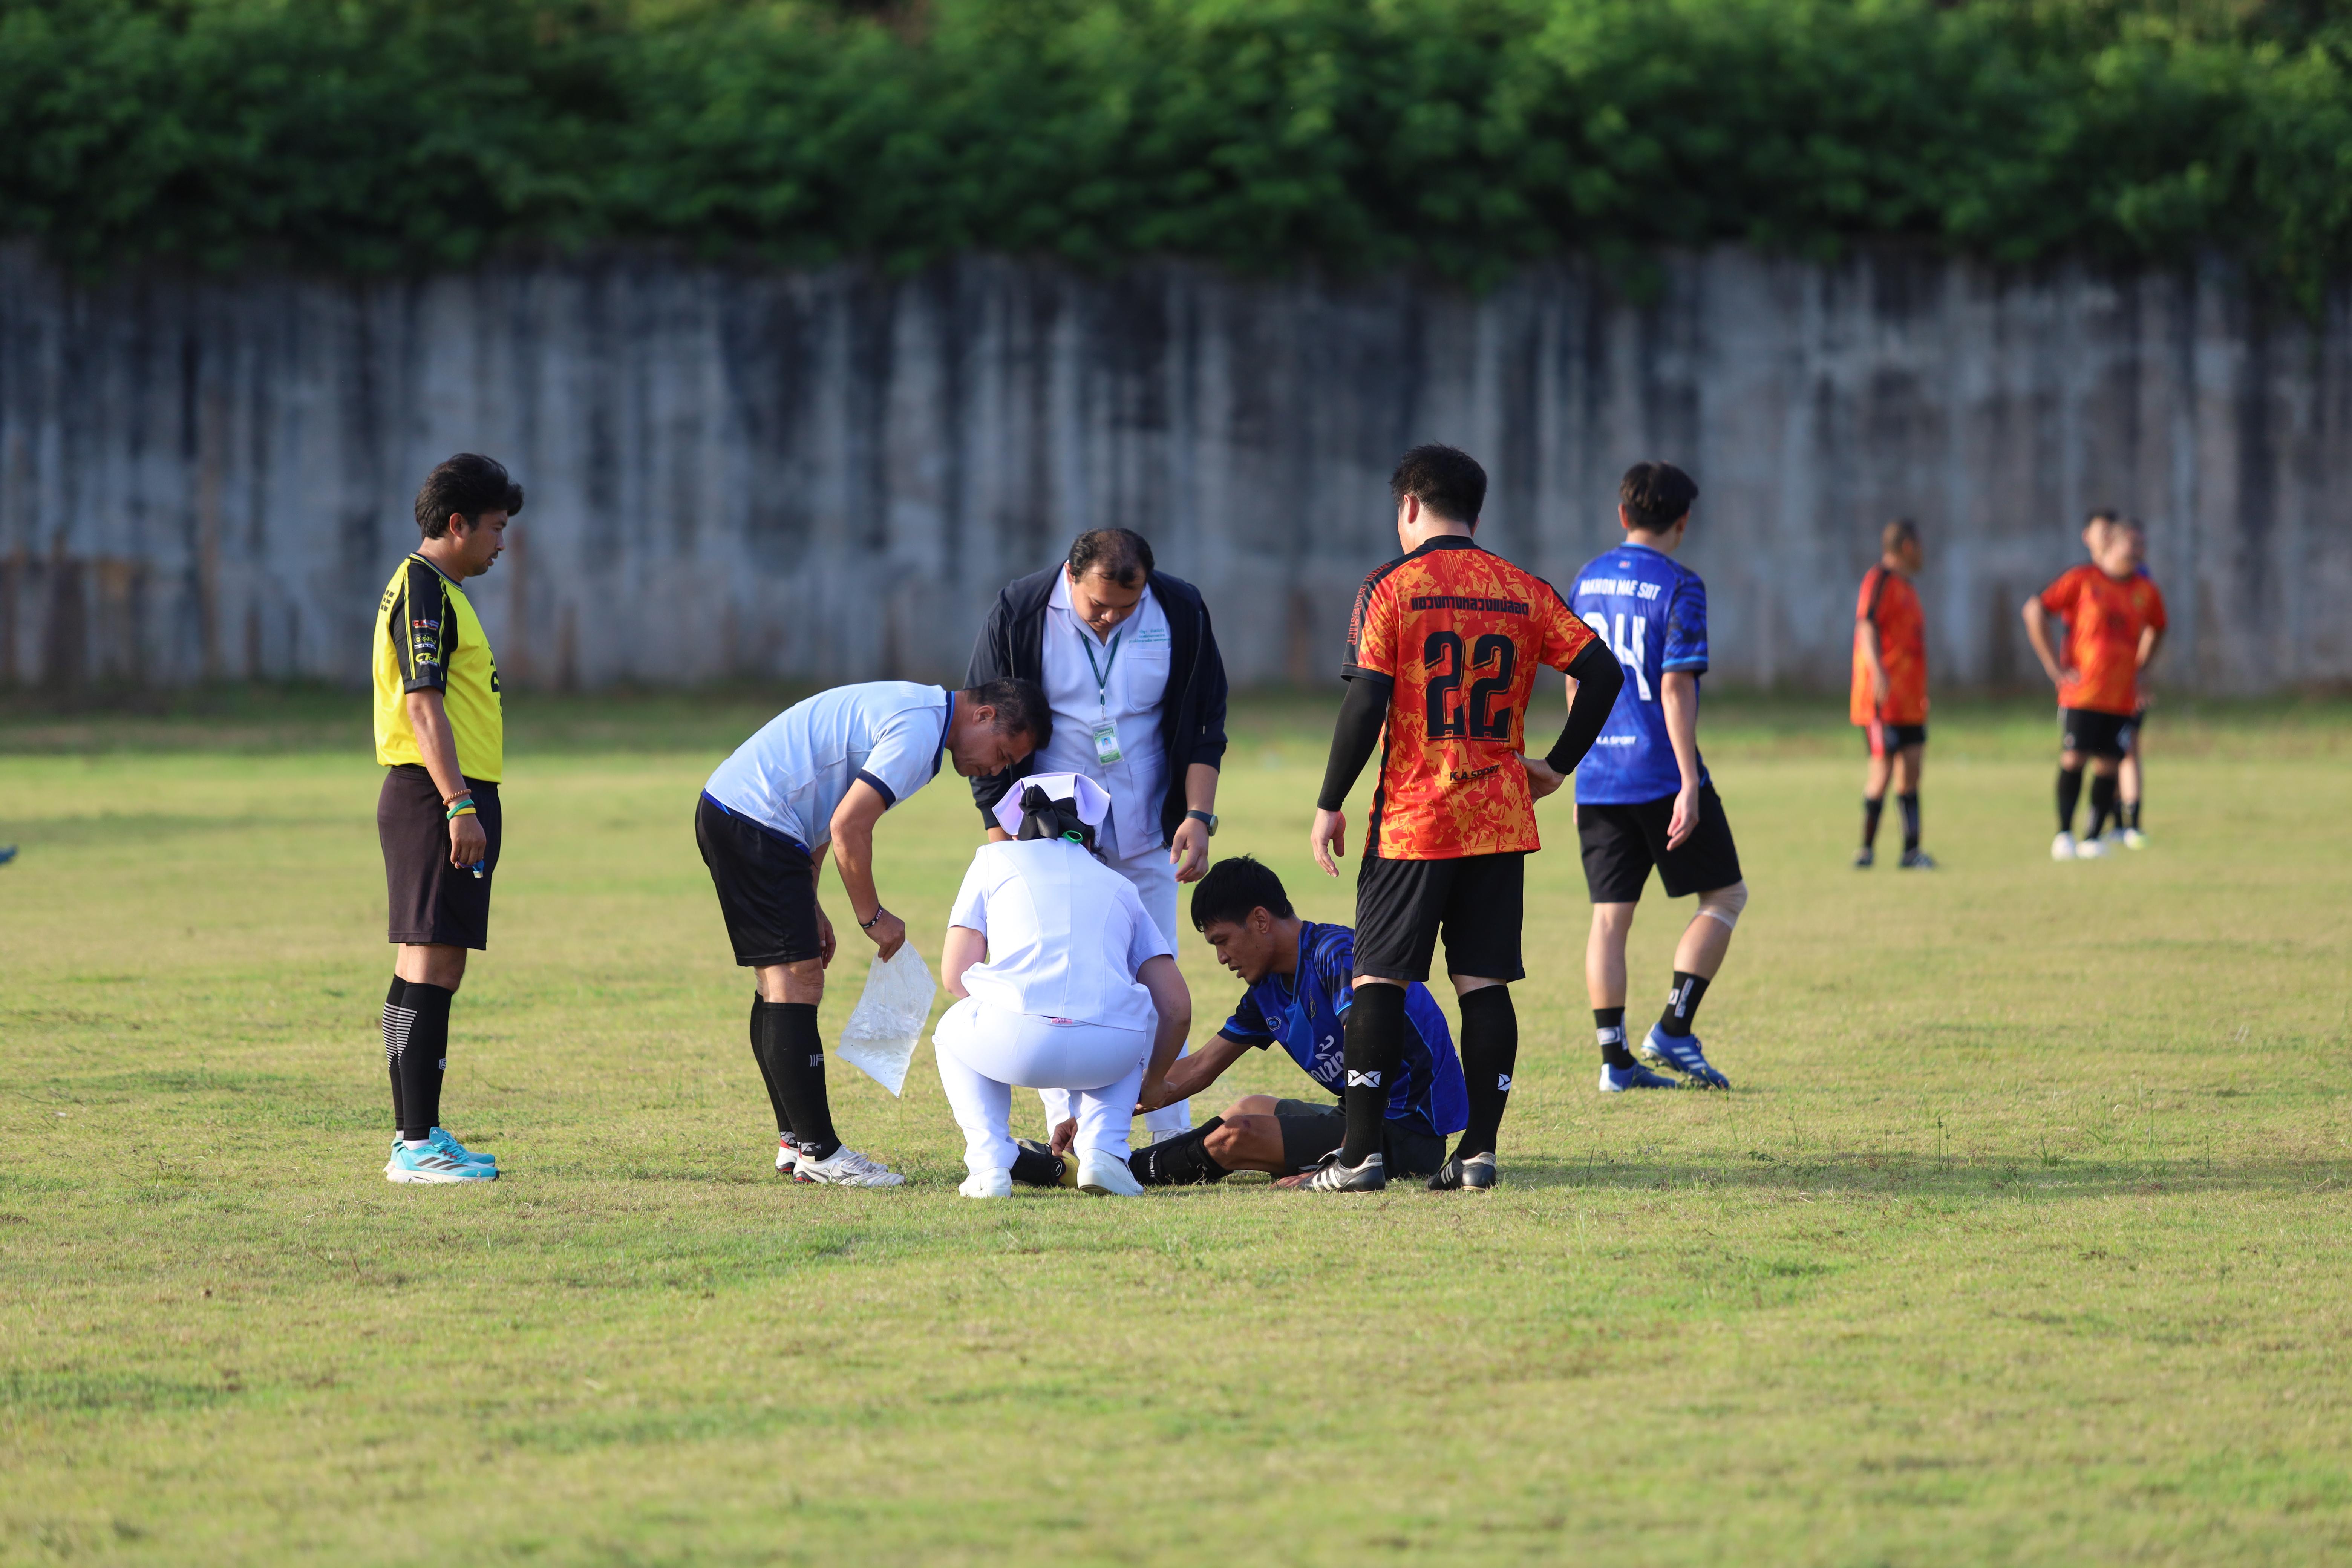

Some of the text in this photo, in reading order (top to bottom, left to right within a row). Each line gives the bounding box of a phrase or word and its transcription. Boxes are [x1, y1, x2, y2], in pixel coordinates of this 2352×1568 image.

[1616, 579, 1638, 596] MAE
[1637, 582, 1662, 601] SOT
[1424, 631, 1518, 742] 22
